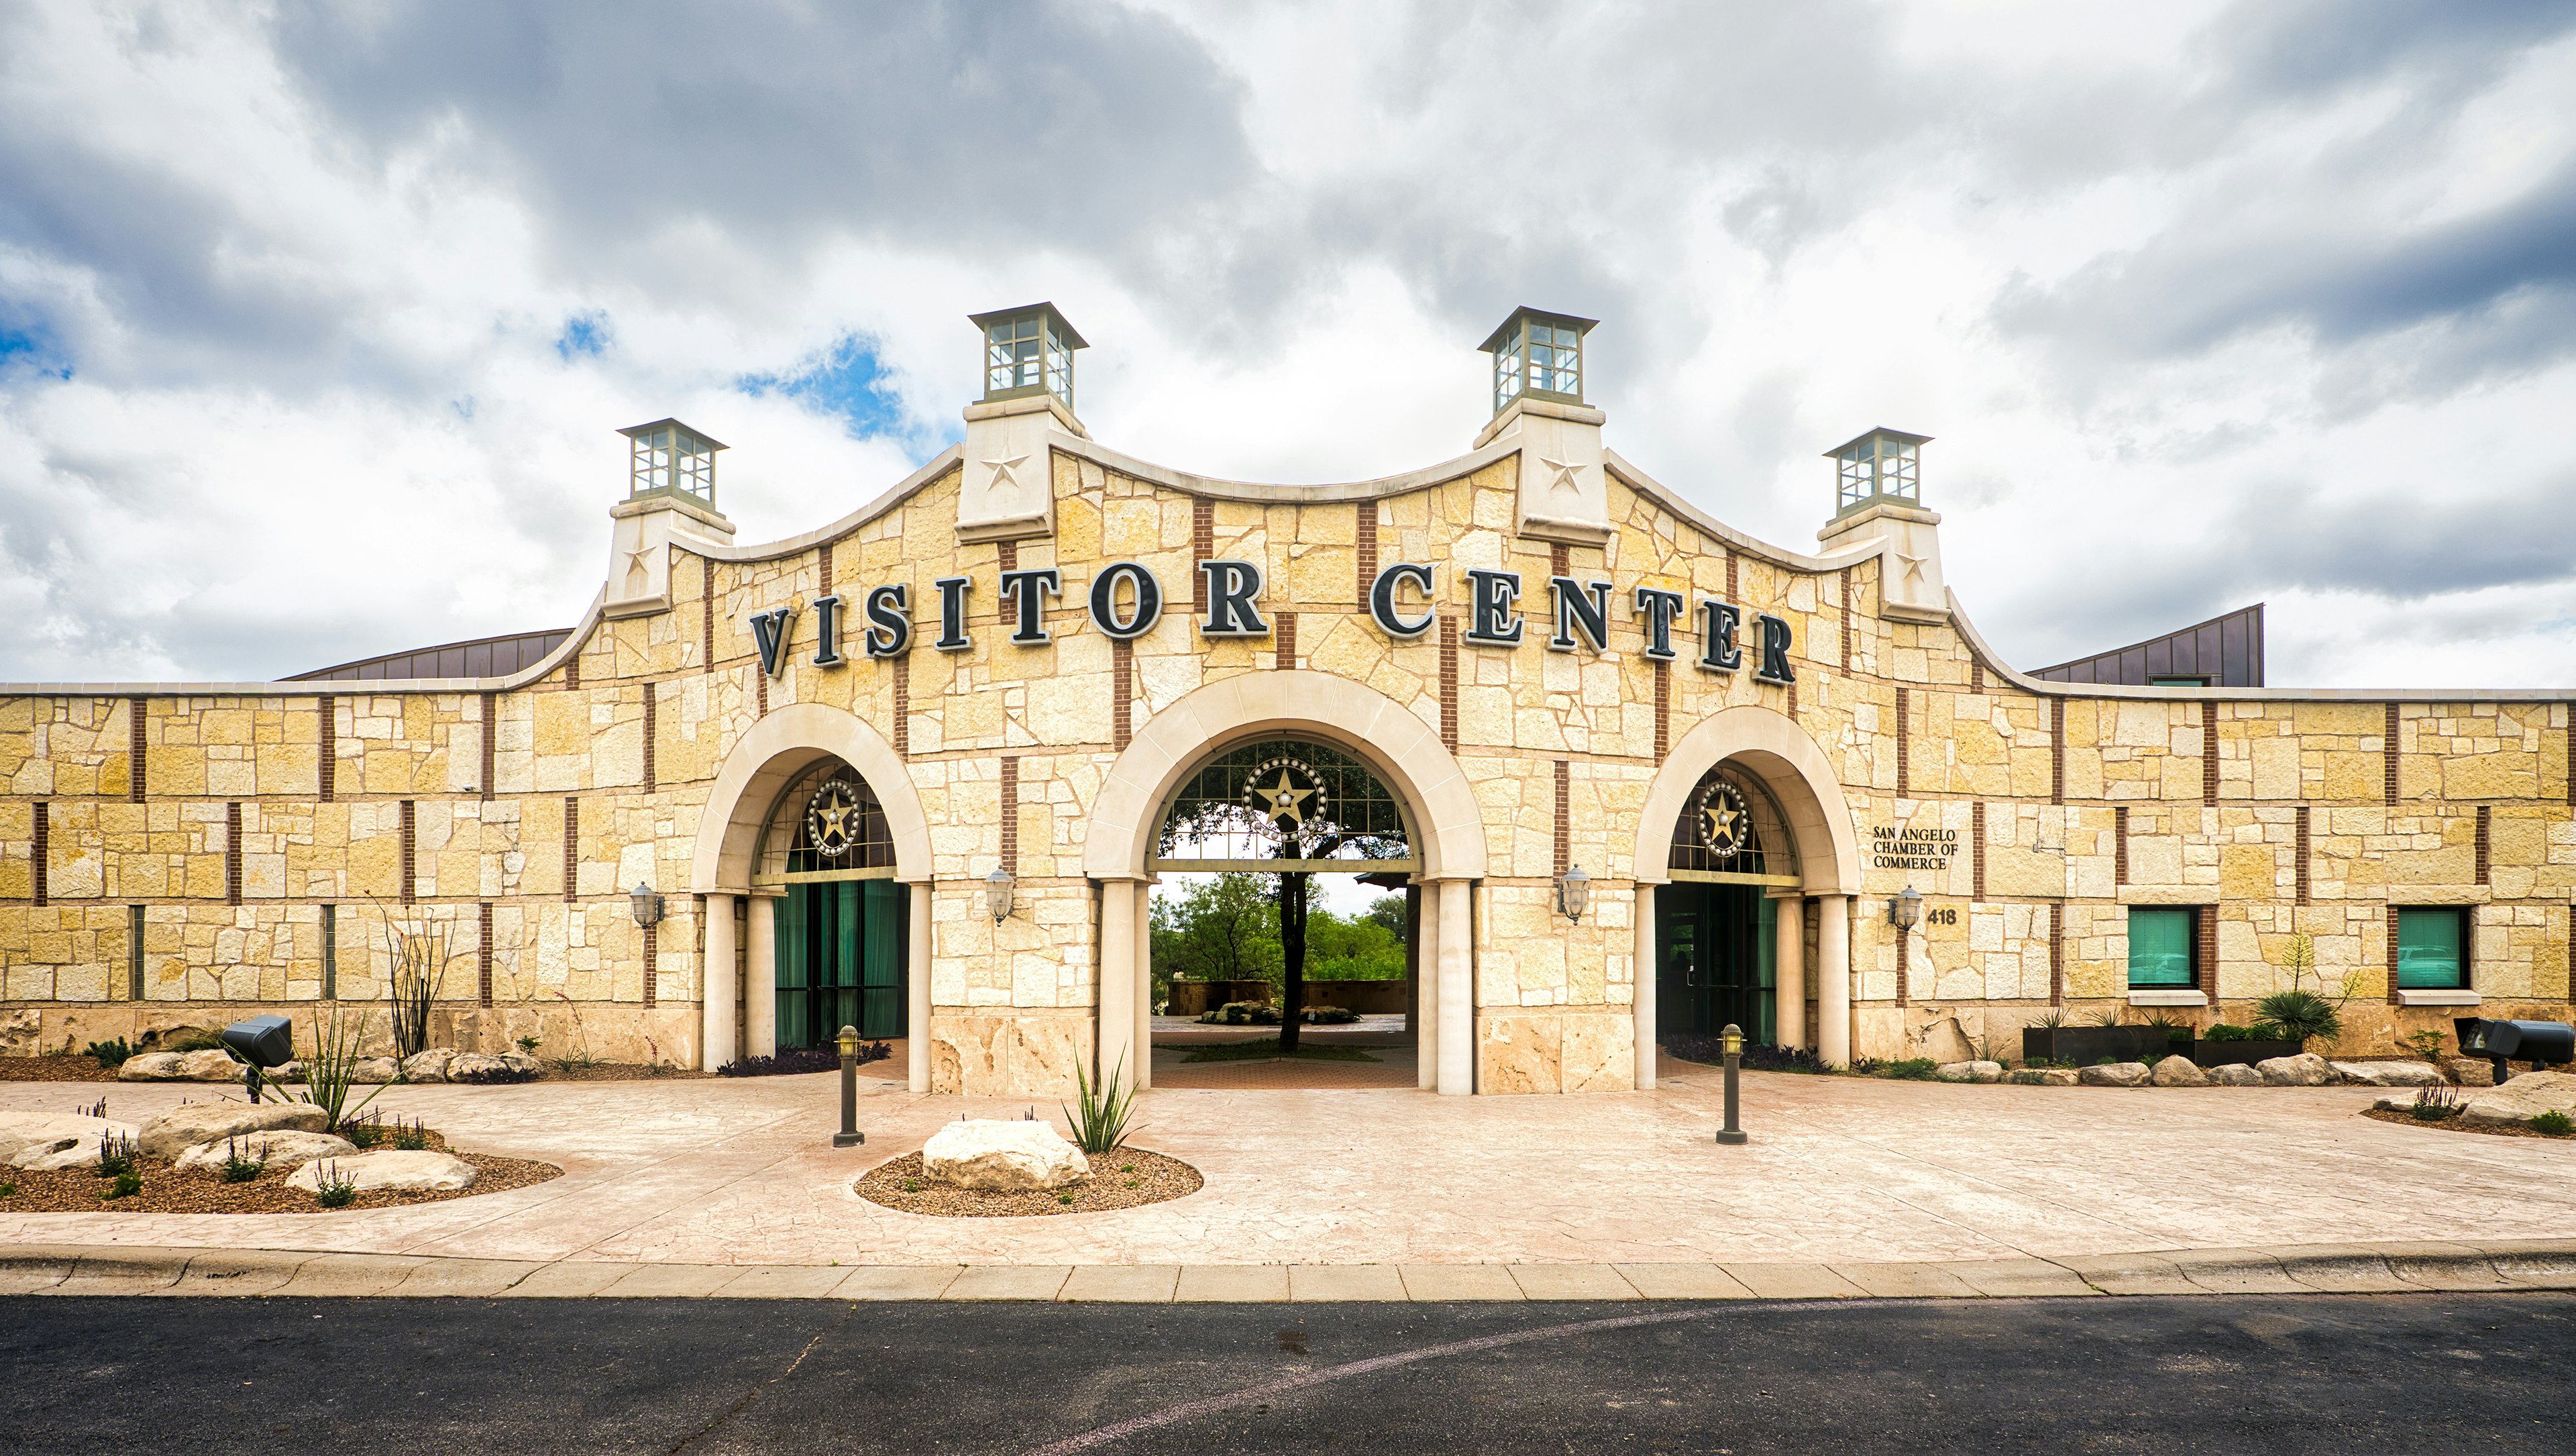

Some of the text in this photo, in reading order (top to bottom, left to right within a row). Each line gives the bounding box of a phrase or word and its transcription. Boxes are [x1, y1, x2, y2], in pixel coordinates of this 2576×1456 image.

[749, 558, 1796, 686] VISITOR CENTER
[1874, 826, 1955, 841] SAN ANGELO
[1874, 841, 1958, 855] CHAMBER OF
[1874, 855, 1947, 870] COMMERCE
[1927, 909, 1957, 925] 418
